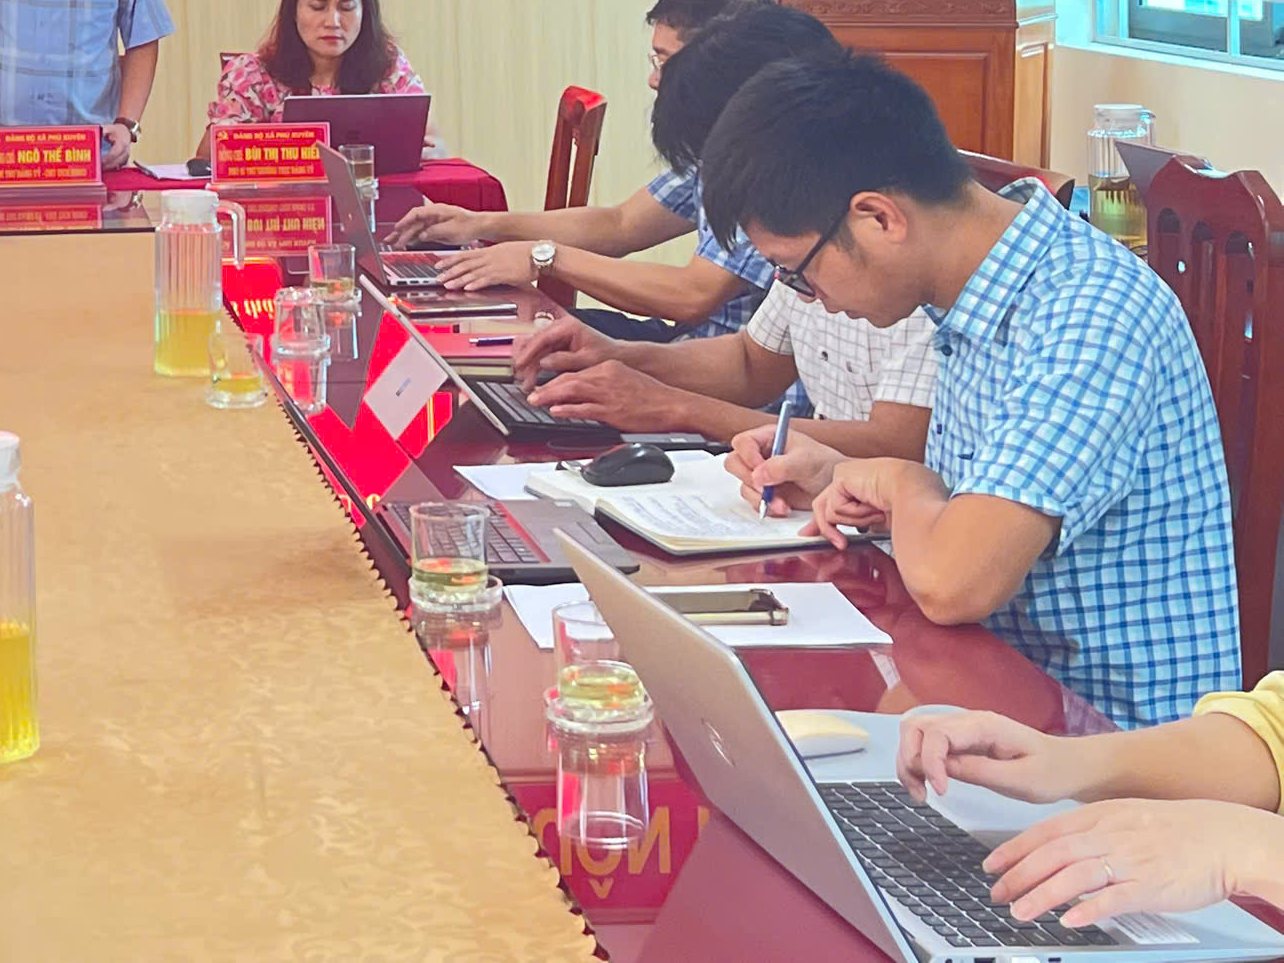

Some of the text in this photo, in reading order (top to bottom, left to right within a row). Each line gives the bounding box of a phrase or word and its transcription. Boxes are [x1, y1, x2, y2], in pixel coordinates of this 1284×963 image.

[17, 146, 40, 164] NGÔ
[43, 144, 63, 163] THẾ
[65, 146, 92, 163] BÌNH
[263, 147, 279, 164] THỊ
[281, 146, 299, 160] THU
